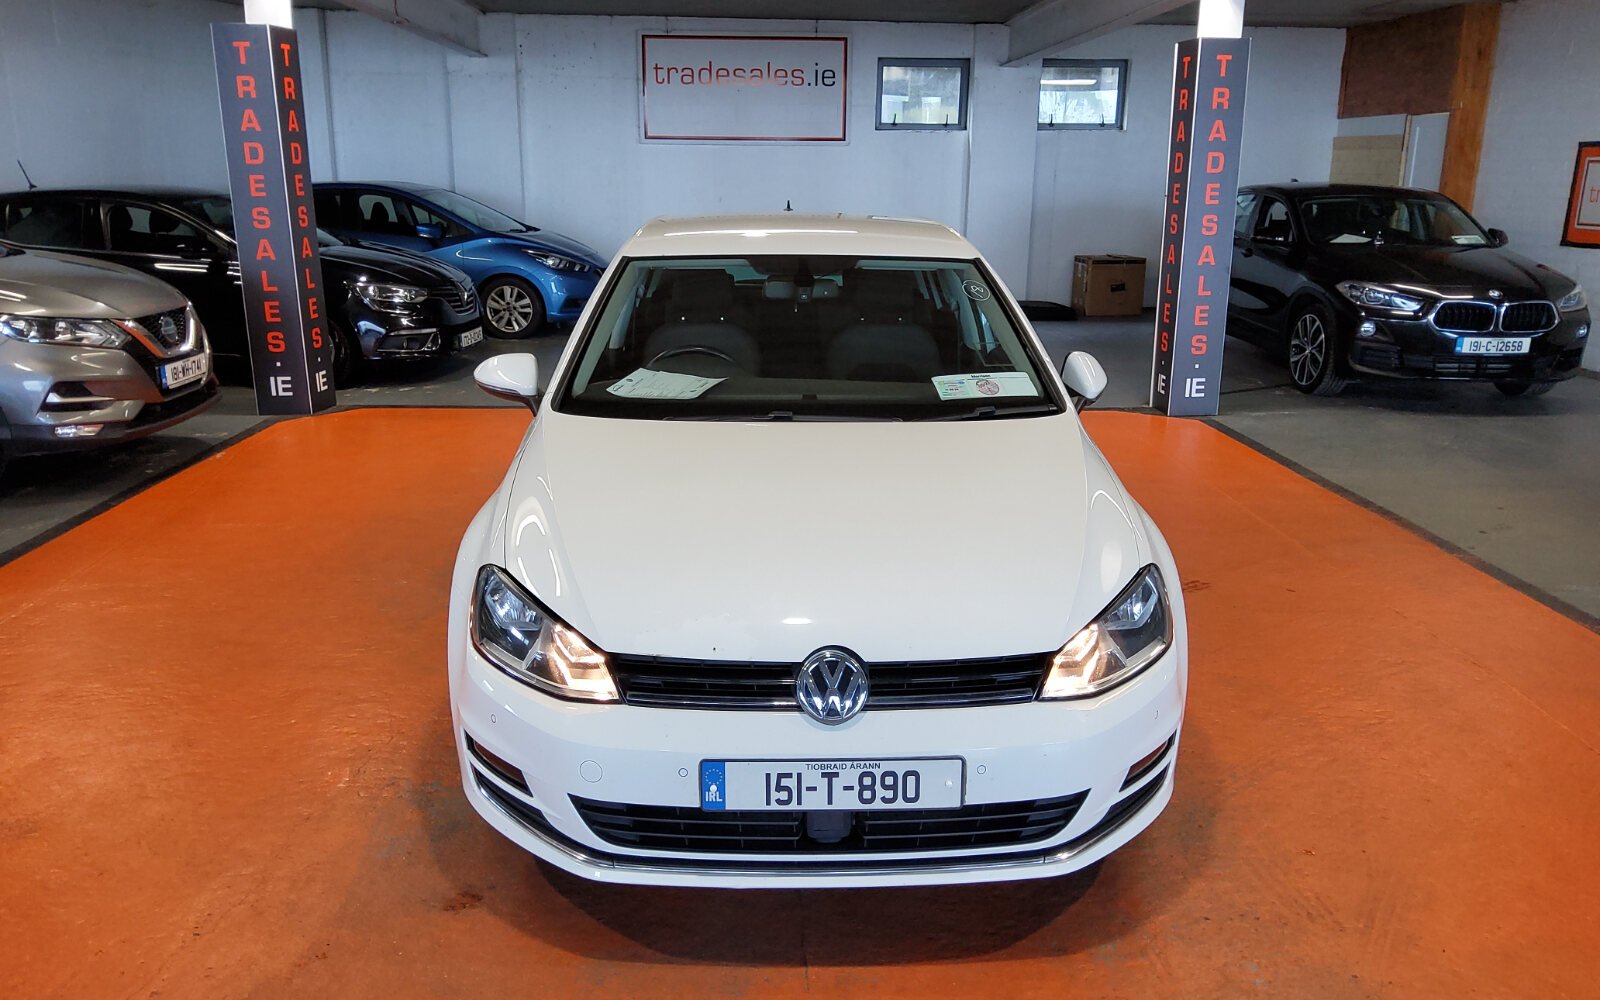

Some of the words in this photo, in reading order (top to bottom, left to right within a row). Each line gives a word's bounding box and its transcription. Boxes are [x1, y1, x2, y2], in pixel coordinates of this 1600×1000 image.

[653, 61, 836, 87] tradesales.ie
[1468, 340, 1524, 352] 191-C-12658
[805, 763, 847, 771] TIOBRAID
[849, 761, 881, 770] ÁRANN
[705, 790, 723, 802] IRL
[765, 770, 921, 806] 151-T-890
